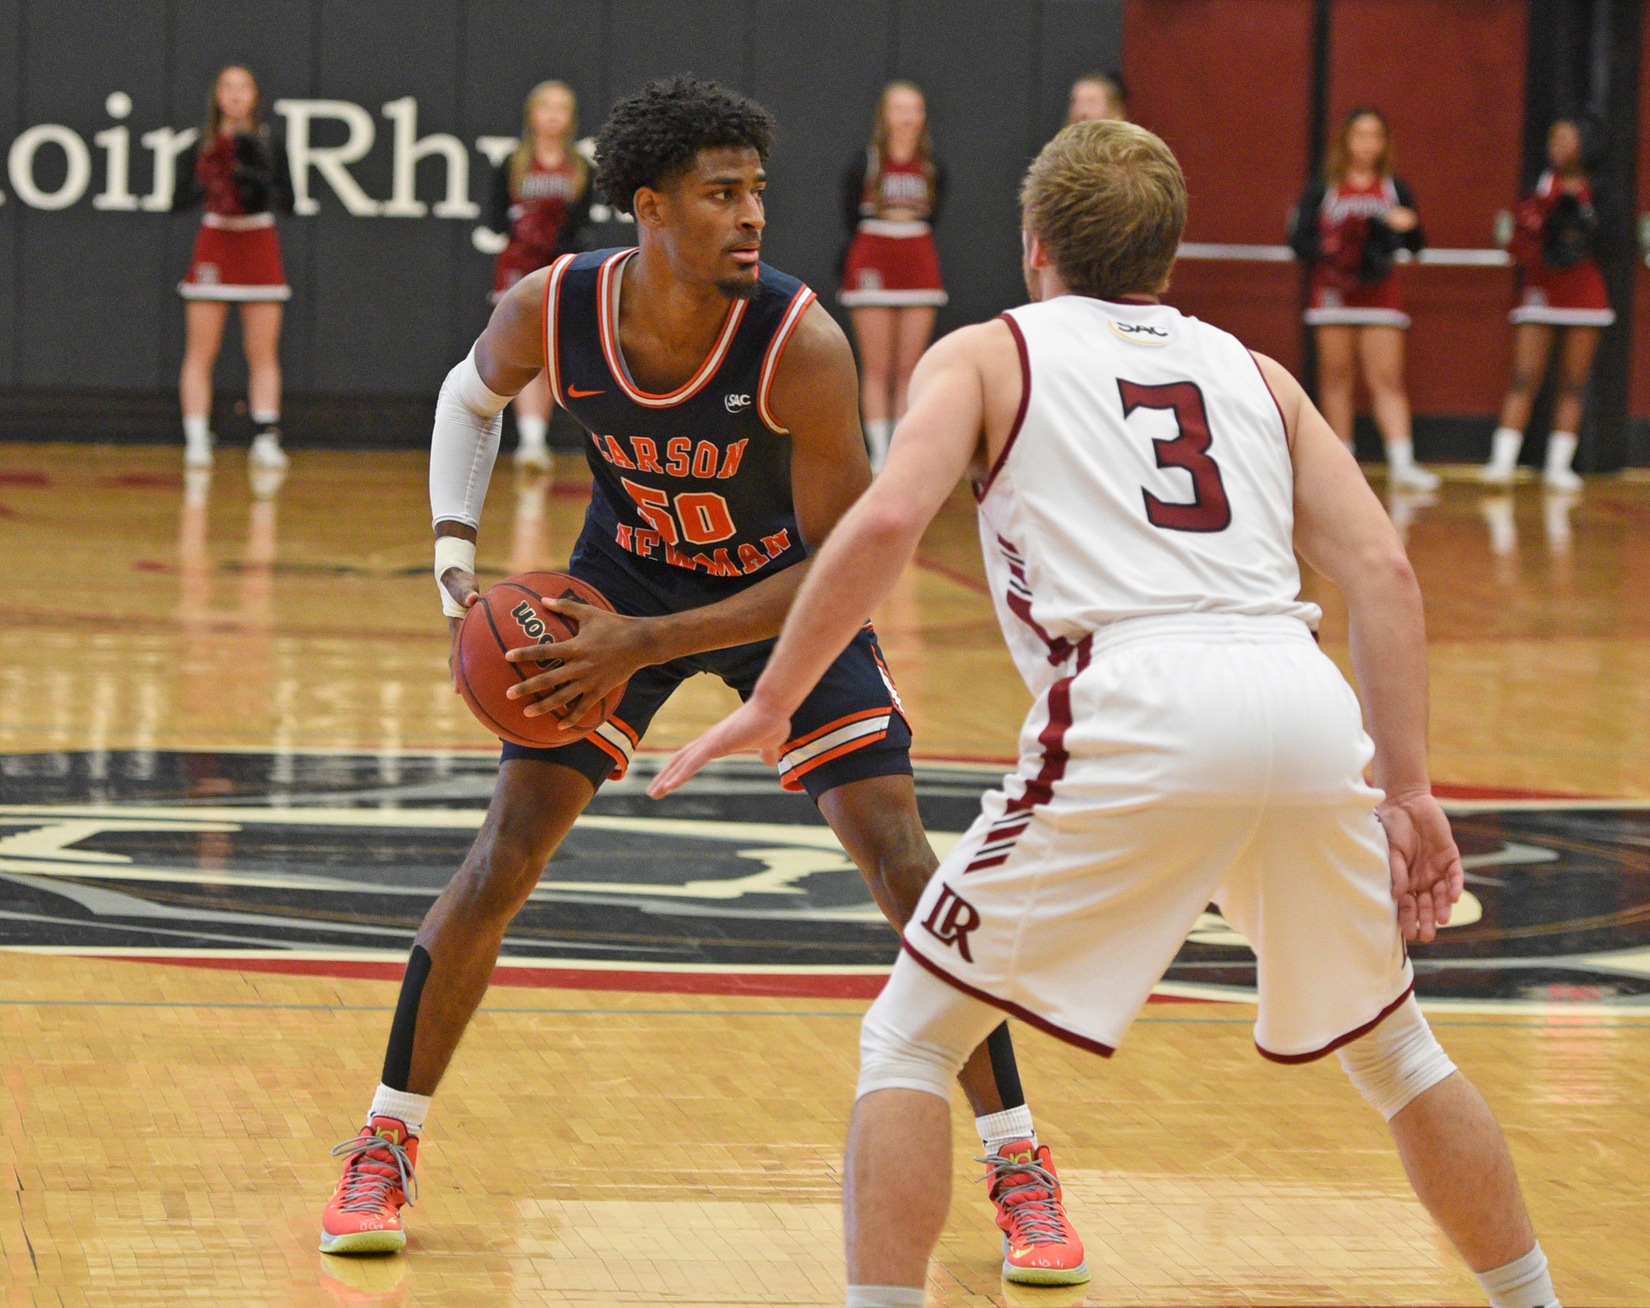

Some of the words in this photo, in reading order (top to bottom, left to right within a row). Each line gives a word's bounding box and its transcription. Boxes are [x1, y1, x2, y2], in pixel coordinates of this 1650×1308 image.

[0, 90, 200, 212] oir
[726, 393, 752, 408] SAC
[1116, 377, 1232, 533] 3
[620, 476, 737, 546] 50
